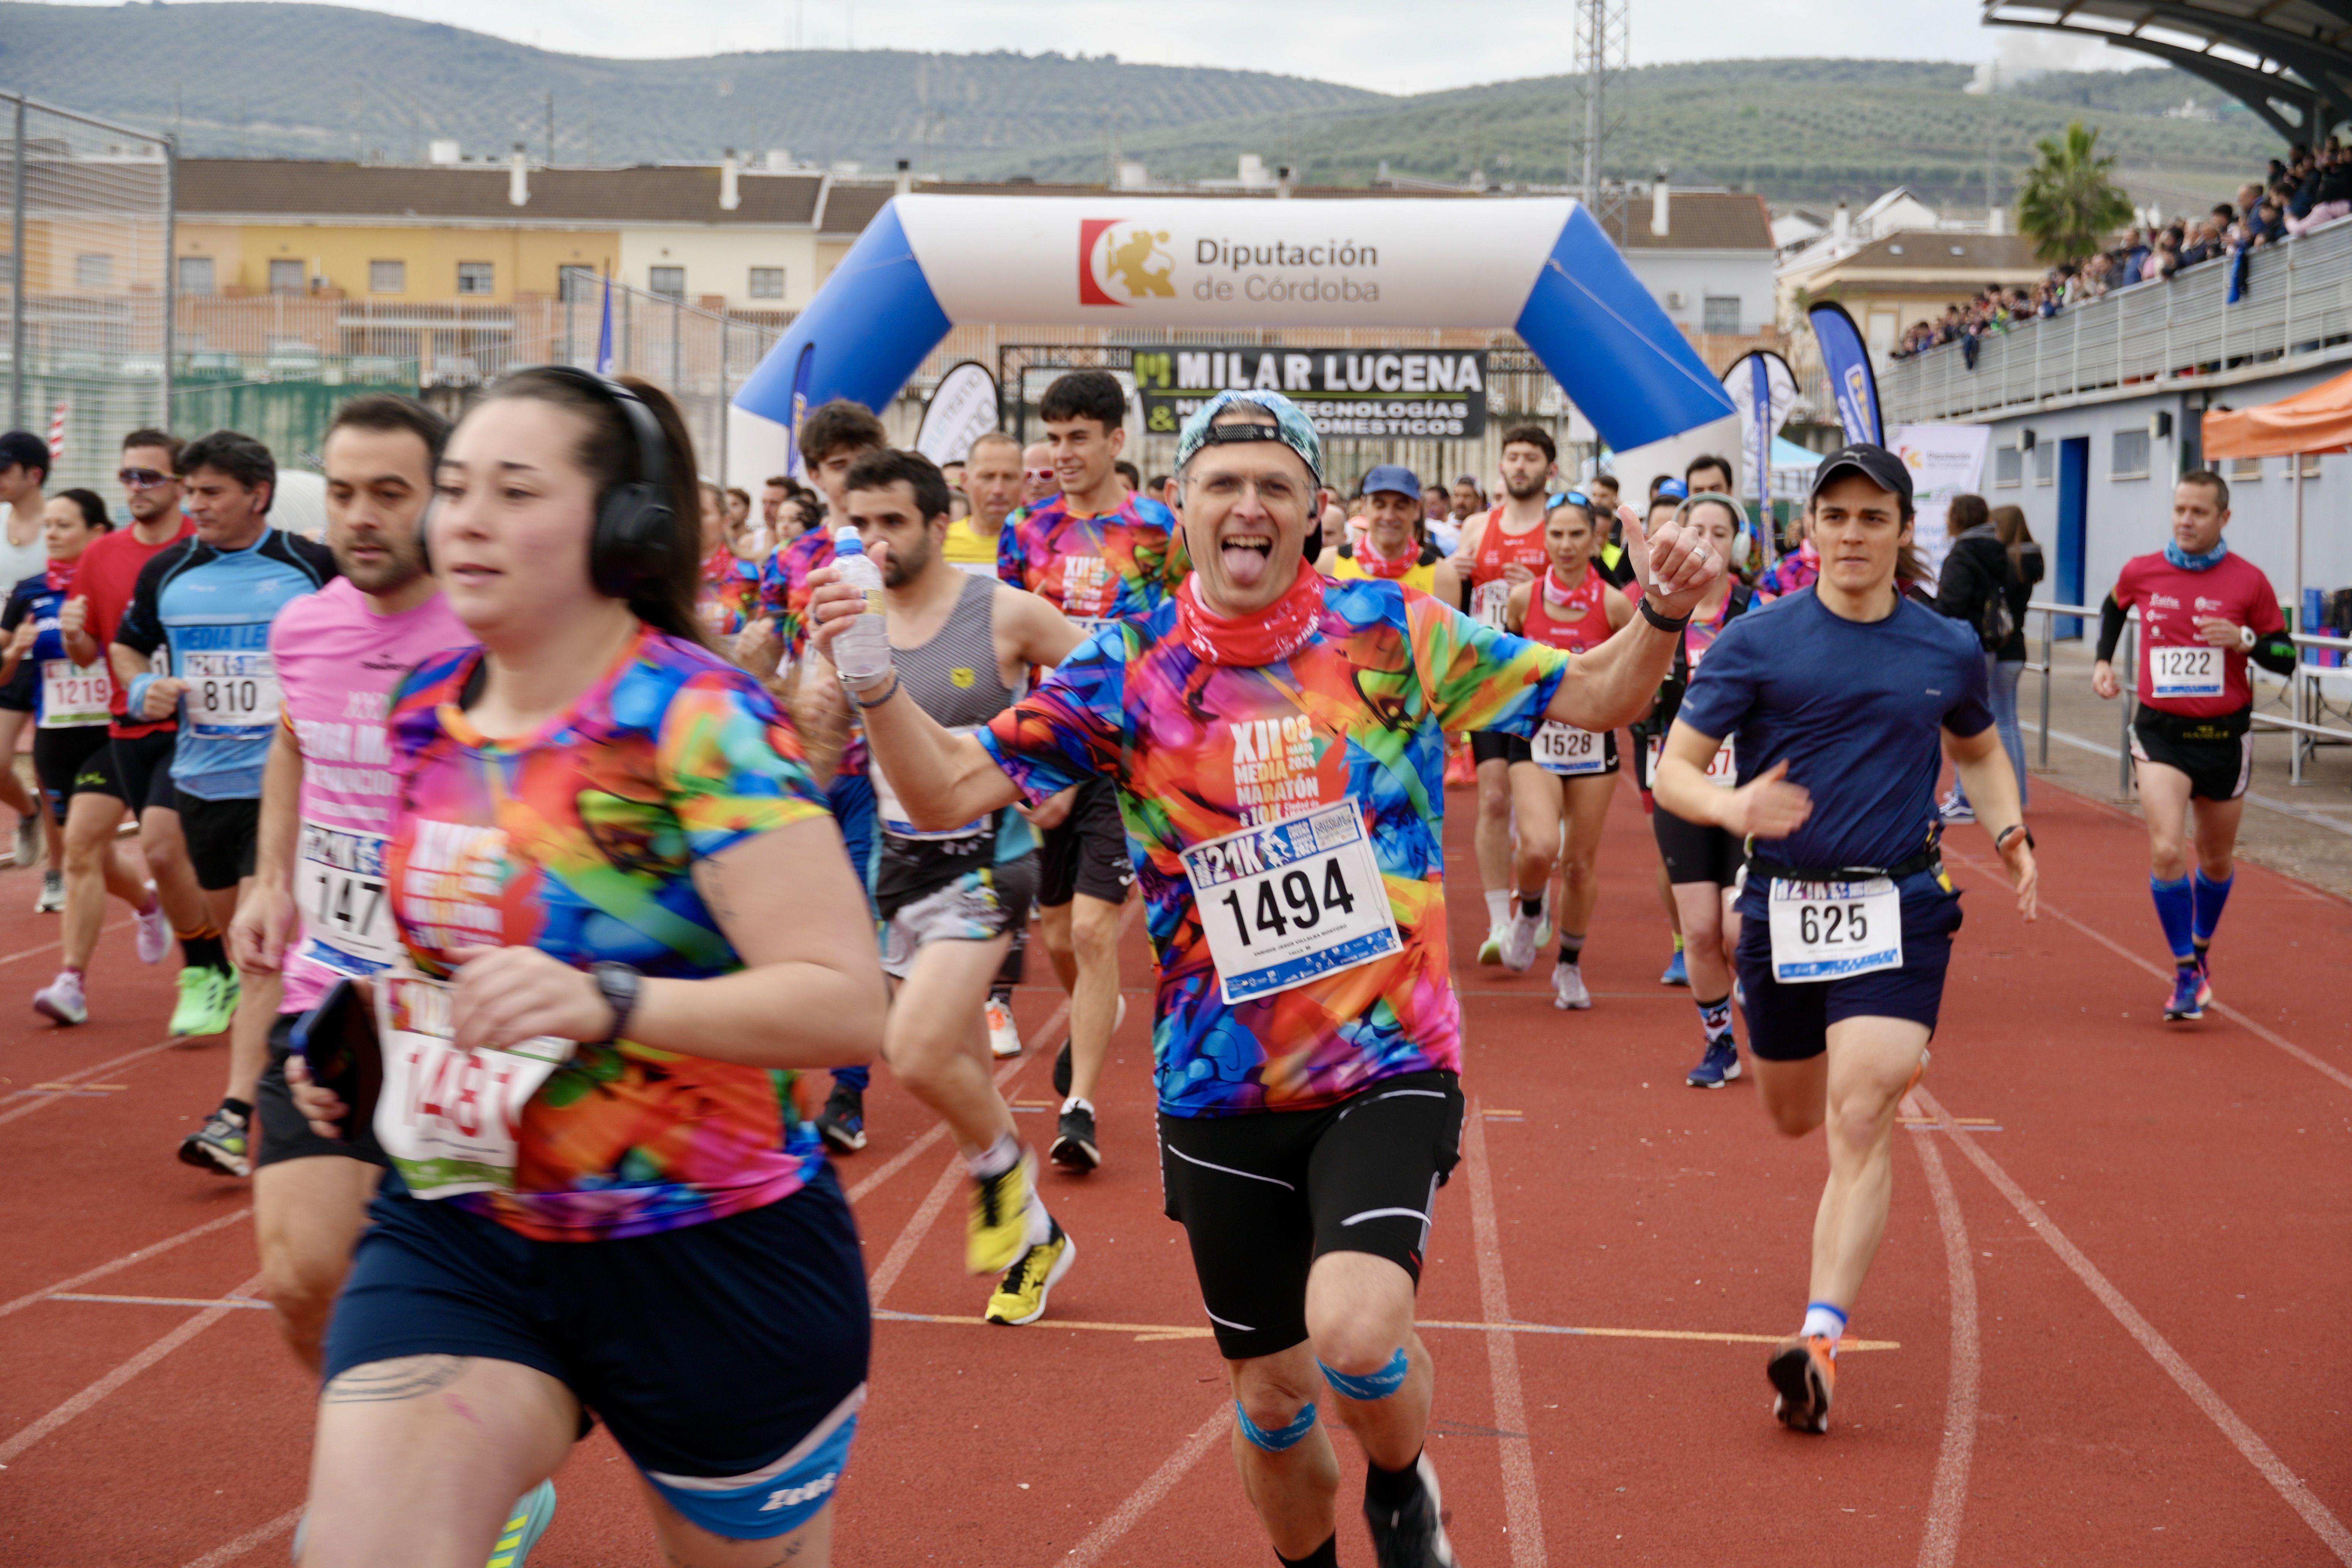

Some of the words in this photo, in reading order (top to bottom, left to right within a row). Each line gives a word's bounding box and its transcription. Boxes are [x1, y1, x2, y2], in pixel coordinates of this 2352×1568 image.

[1195, 237, 1378, 271] Diputación
[1193, 275, 1234, 301] de
[1244, 274, 1379, 302] Córdoba
[1177, 352, 1312, 391] MILAR
[1324, 354, 1484, 392] LUCENA
[1148, 405, 1177, 432] &
[2161, 652, 2210, 675] 1222
[56, 679, 108, 705] 1219
[204, 681, 256, 711] 810
[1229, 718, 1283, 764] XII
[1282, 714, 1313, 743] 08
[1542, 733, 1592, 756] 1528
[1233, 759, 1289, 785] MEDIA
[1288, 754, 1316, 771] 2026
[1236, 773, 1320, 807] MARATÓN
[1239, 812, 1250, 828] &
[1205, 835, 1265, 884] 21K
[1222, 857, 1355, 947] 1494
[1800, 902, 1867, 944] 625
